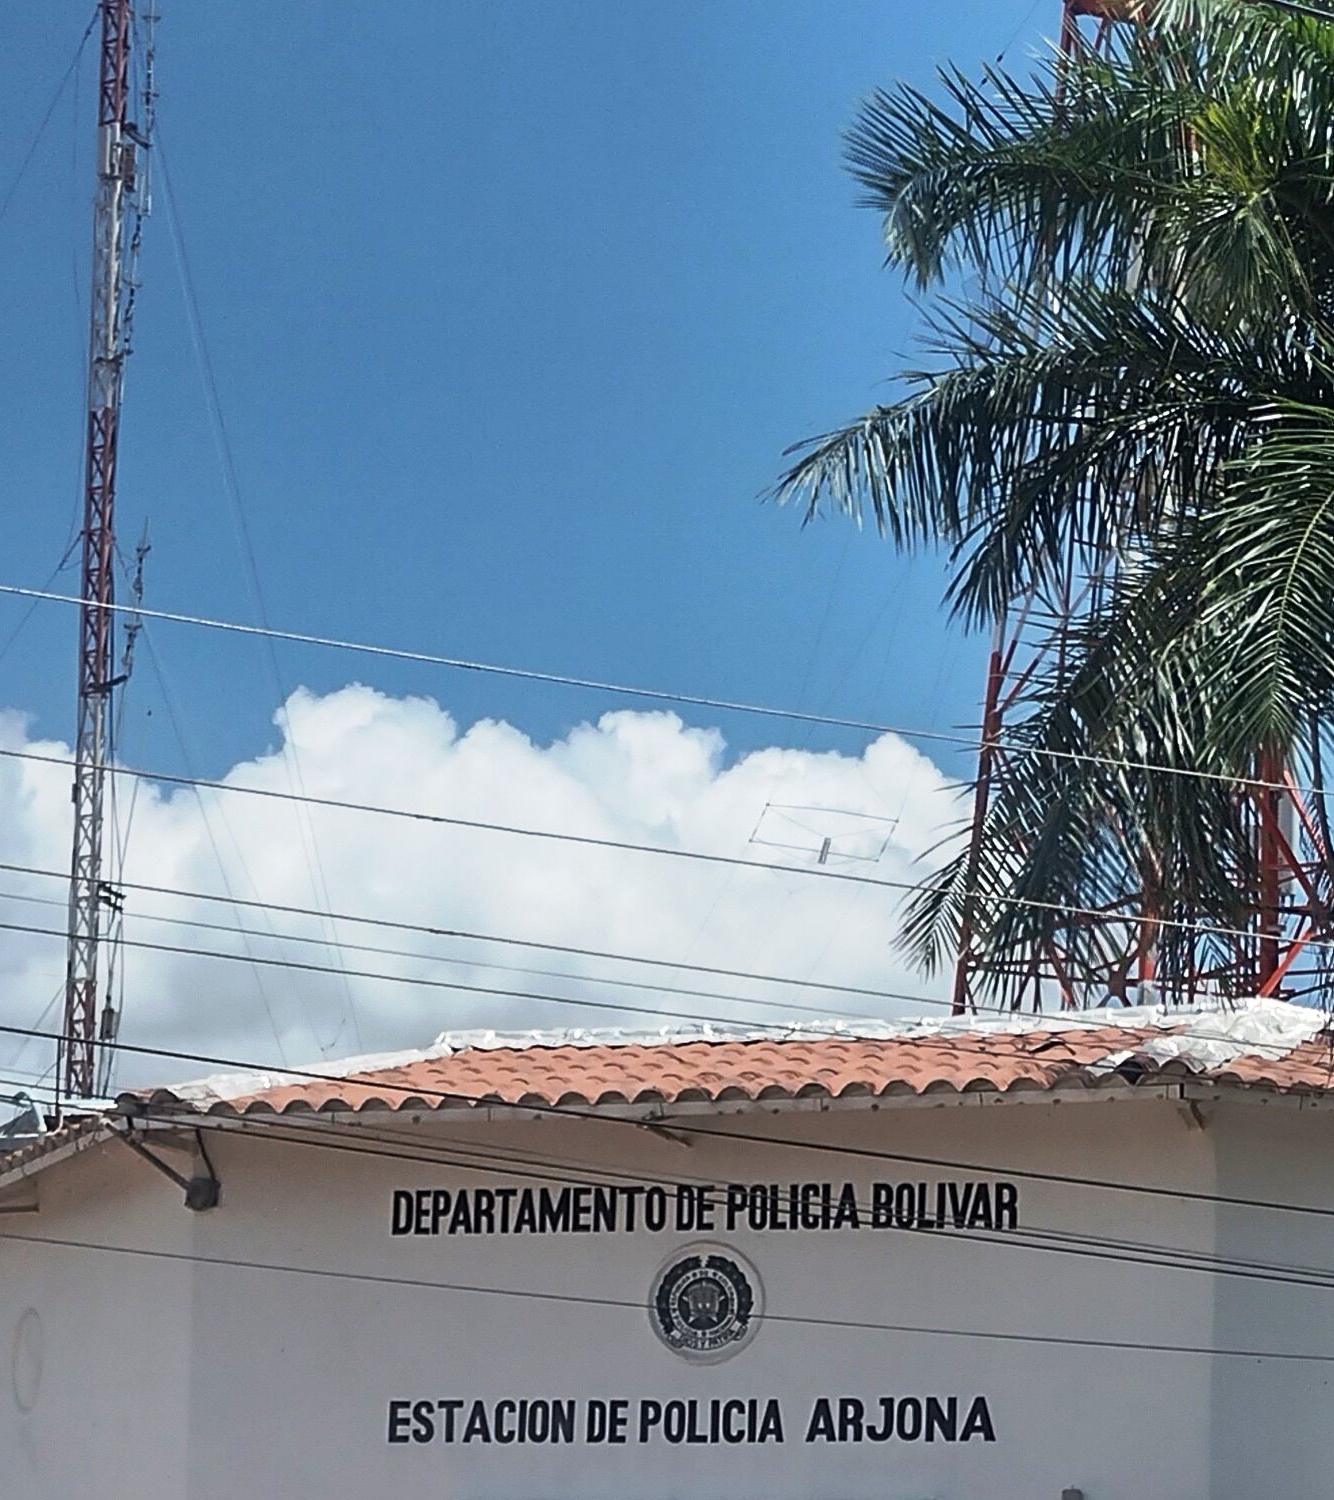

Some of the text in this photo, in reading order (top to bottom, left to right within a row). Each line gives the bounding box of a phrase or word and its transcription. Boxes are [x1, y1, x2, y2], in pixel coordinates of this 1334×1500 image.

[390, 1181, 1019, 1236] DEPARTAMENTO DE POLICIA BOLIVAR
[388, 1396, 997, 1444] ESTACION DE POLICIA ARJONA
